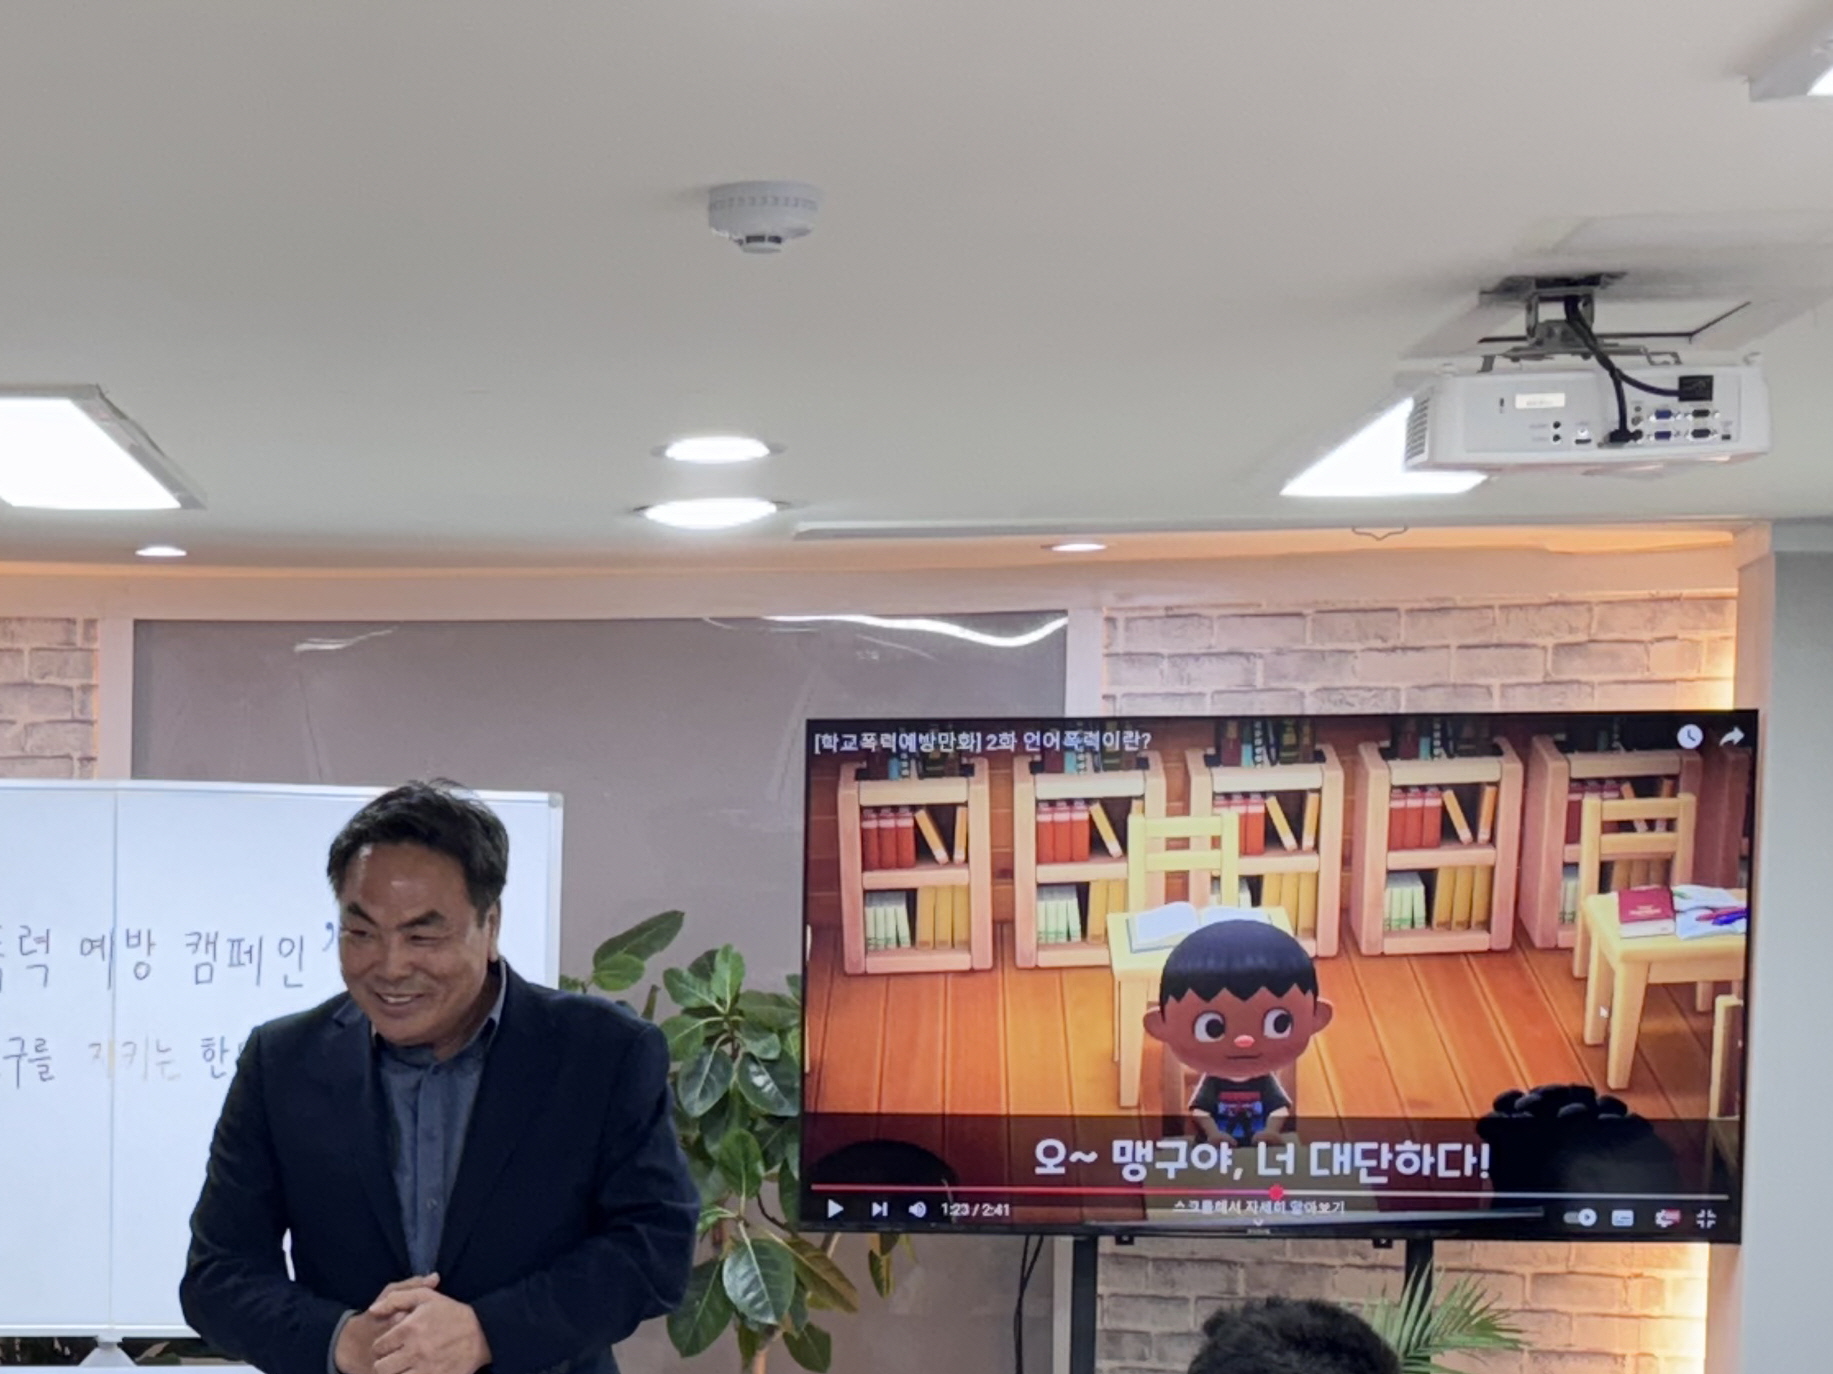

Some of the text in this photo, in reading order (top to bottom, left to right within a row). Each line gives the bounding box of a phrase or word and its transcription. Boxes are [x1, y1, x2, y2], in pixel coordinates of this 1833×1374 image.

[814, 730, 1152, 754] [학교폭력예방만화] 2화 언어폭력이란?
[79, 926, 157, 991] 예방
[1034, 1138, 1491, 1184] 오~ 맹구야, 너 대단하다!
